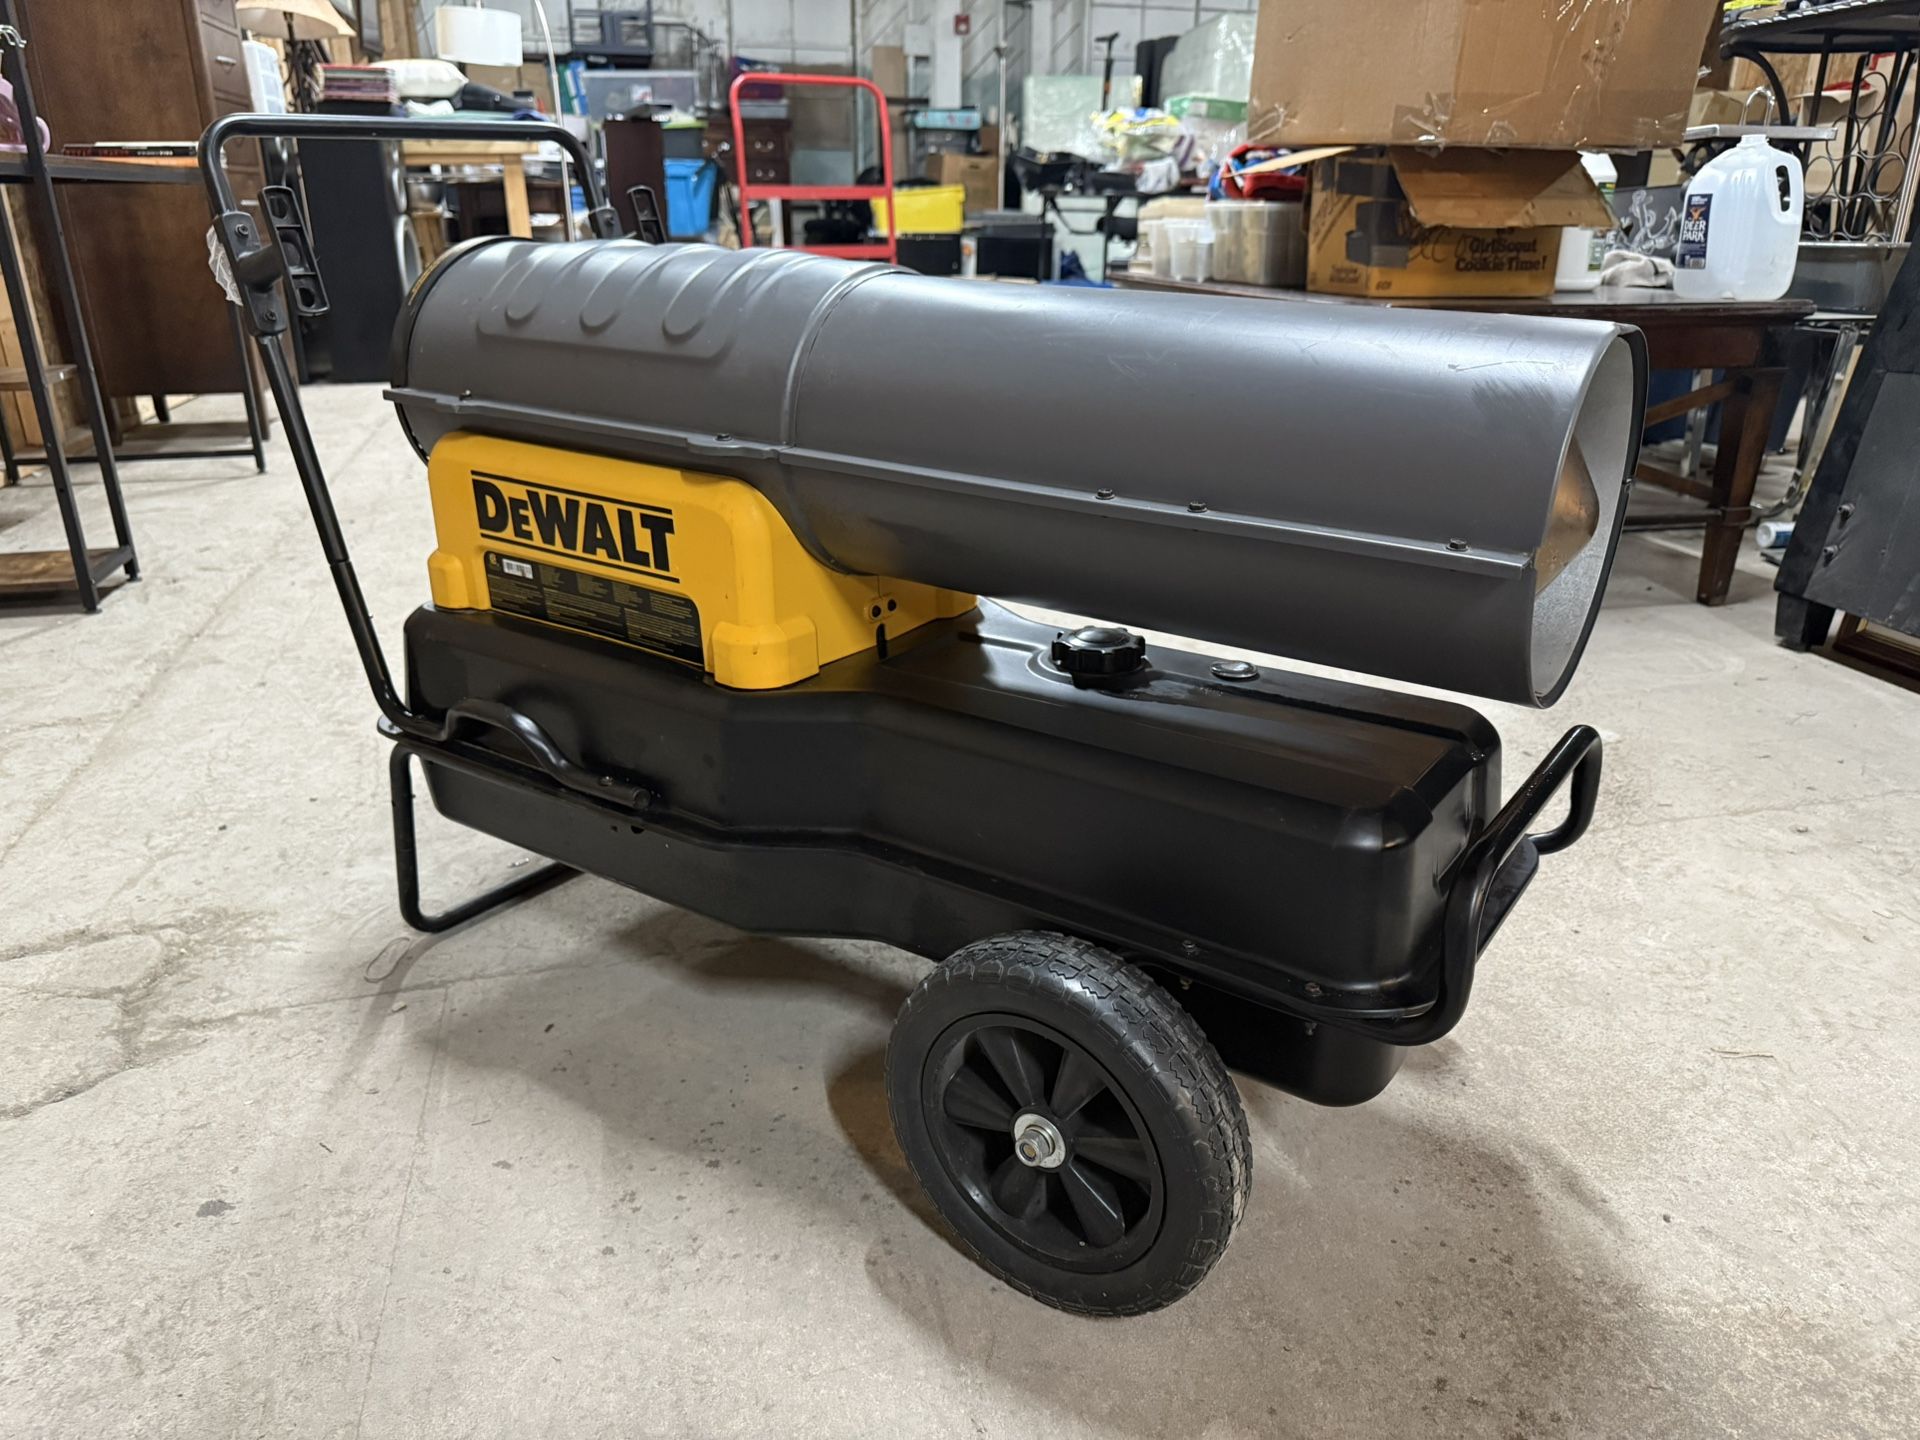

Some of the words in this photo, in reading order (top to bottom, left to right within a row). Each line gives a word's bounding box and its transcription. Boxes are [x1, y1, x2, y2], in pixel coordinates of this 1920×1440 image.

[1684, 220, 1707, 231] DEER
[1682, 230, 1706, 242] PARK
[1455, 256, 1504, 272] Cookie
[1507, 255, 1548, 271] Time!
